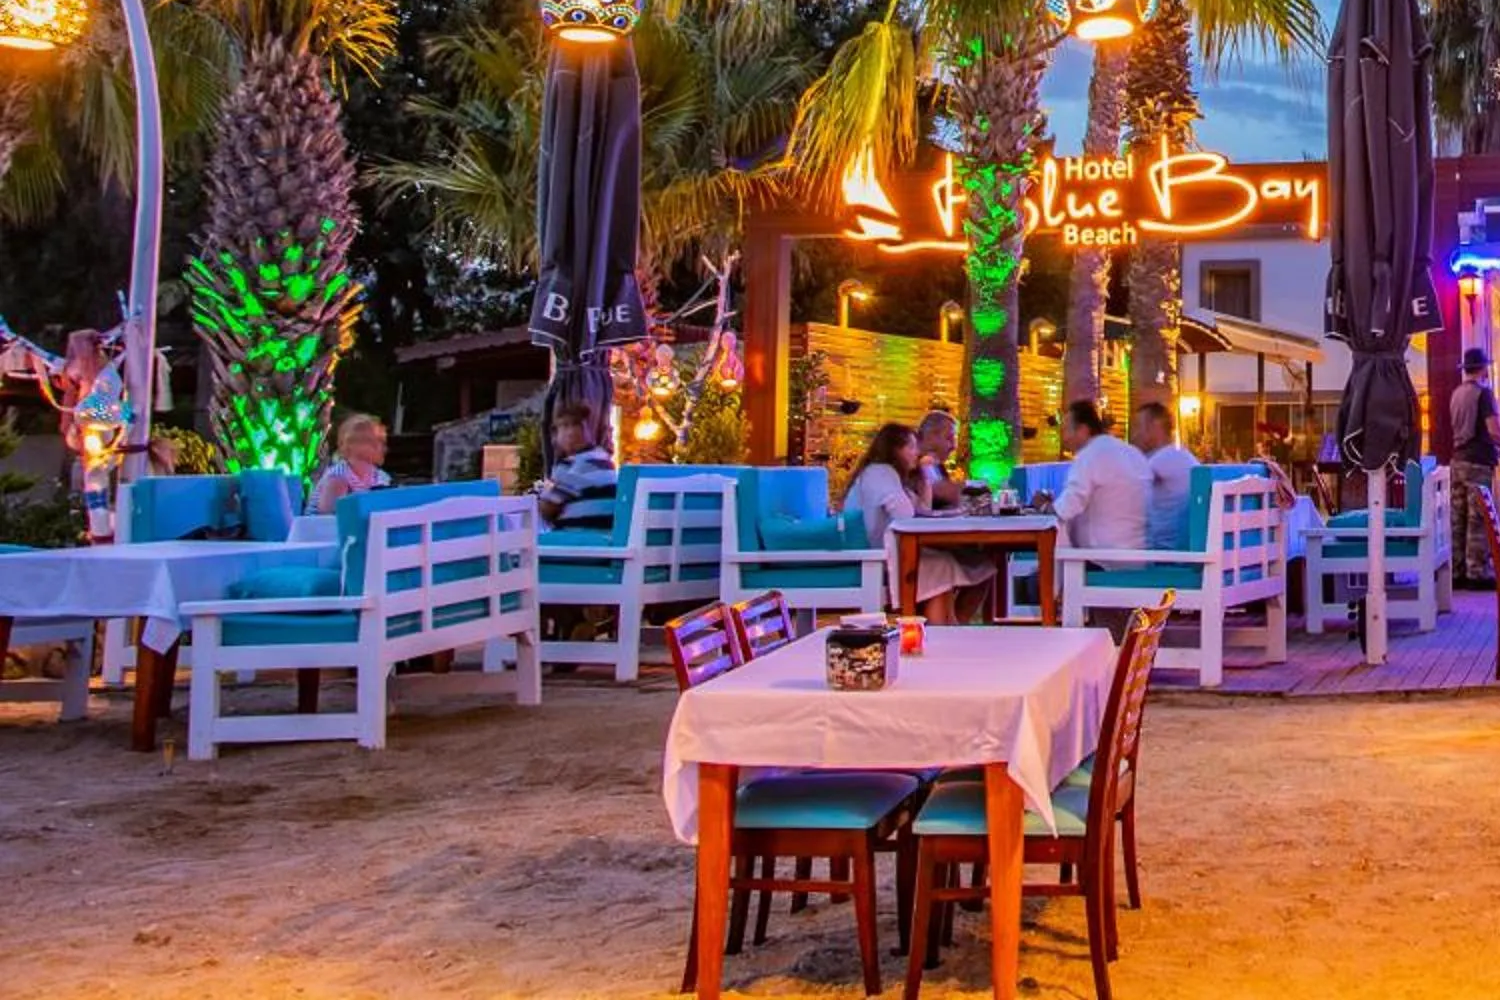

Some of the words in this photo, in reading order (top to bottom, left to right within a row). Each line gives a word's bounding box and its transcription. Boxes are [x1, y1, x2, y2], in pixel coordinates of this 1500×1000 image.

[1064, 154, 1133, 181] Hotel
[1138, 134, 1320, 240] Bay
[1063, 221, 1138, 246] Beach
